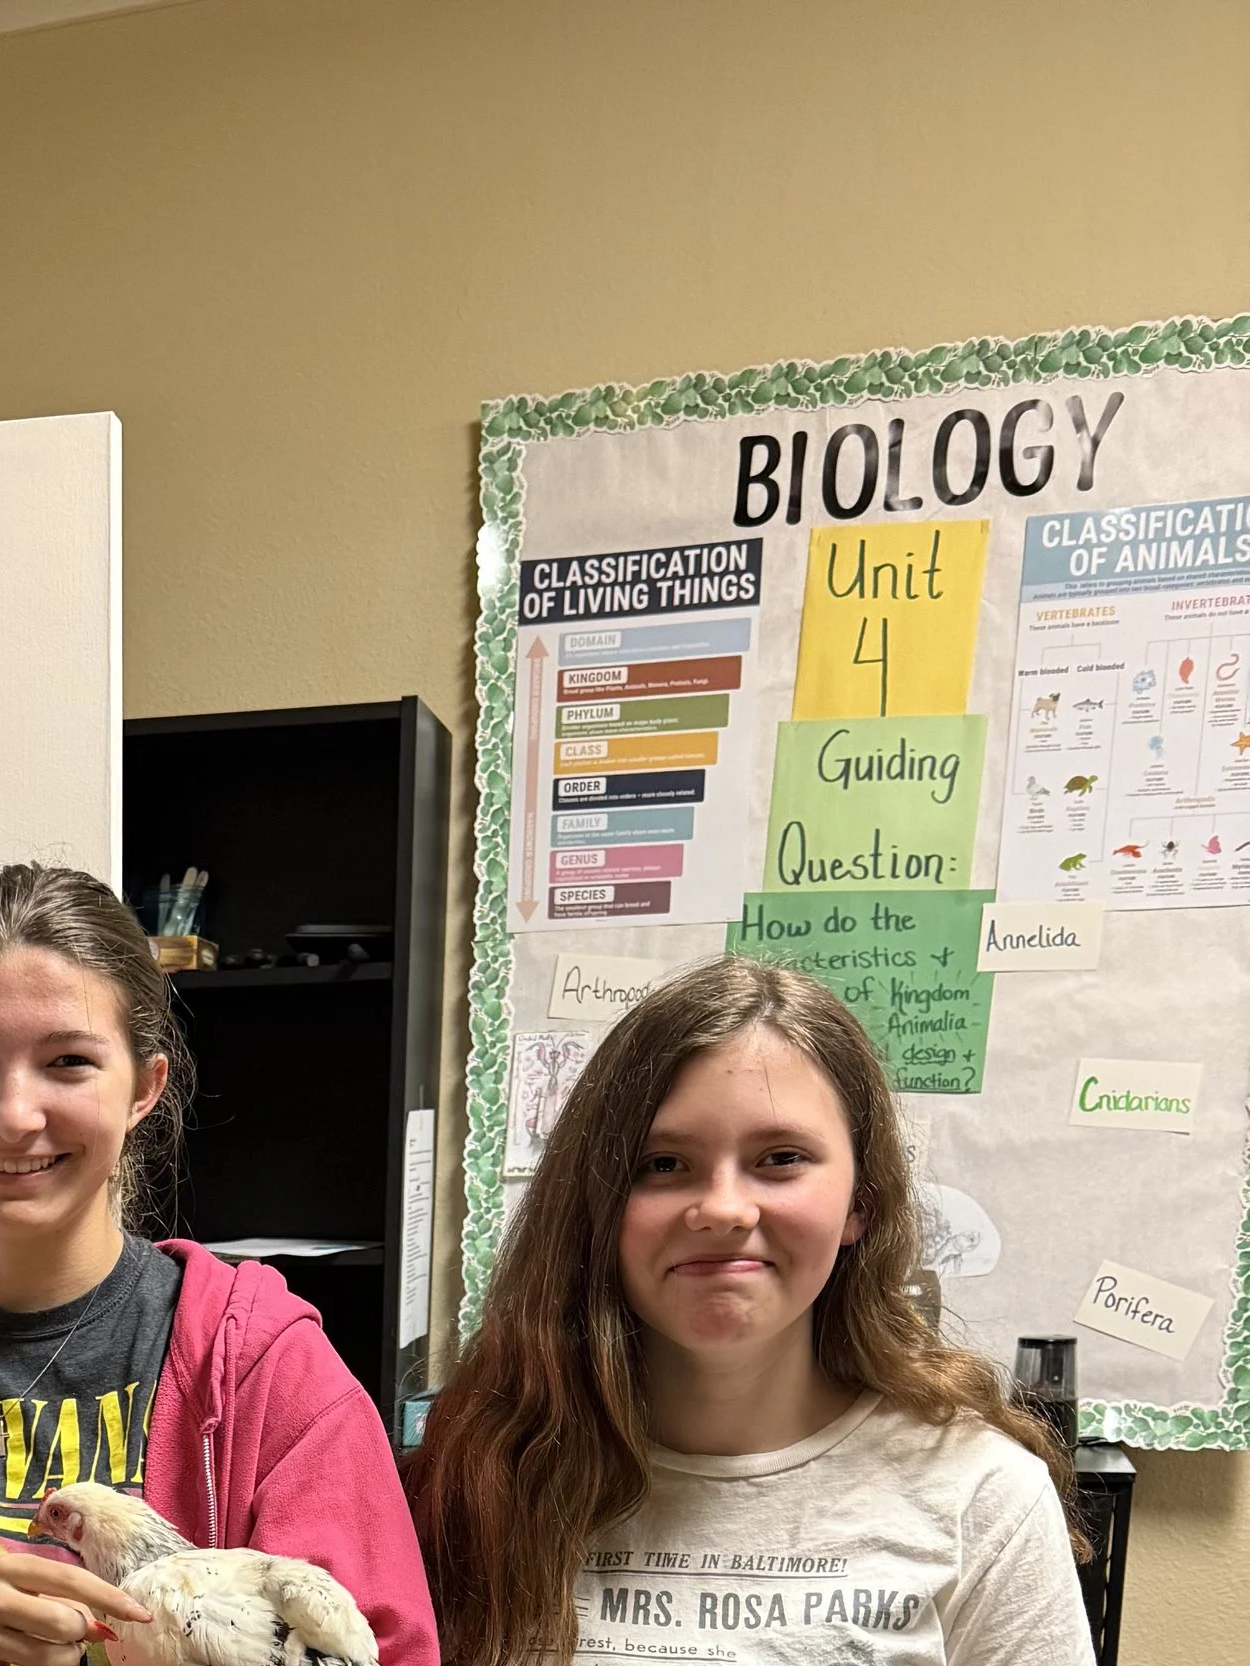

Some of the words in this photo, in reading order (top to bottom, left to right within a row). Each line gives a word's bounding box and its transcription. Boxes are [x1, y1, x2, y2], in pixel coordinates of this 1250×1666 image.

[733, 391, 1125, 528] BIOLOGY
[1041, 503, 1250, 548] CLASSIFICATI
[533, 543, 749, 590] CLASSIFICATION
[826, 529, 945, 601] Unit
[1069, 547, 1107, 577] OF
[1113, 534, 1250, 573] ANIMALS
[522, 591, 556, 619] OF
[563, 583, 649, 616] LIVING
[656, 573, 756, 607] THINGS
[1035, 605, 1117, 622] VERTEBRATES
[569, 634, 617, 649] DOMAIN
[567, 670, 622, 685] KINGDOM
[852, 617, 888, 717] 4
[1039, 665, 1069, 676] blooded
[1077, 663, 1094, 674] Cold
[1095, 661, 1125, 673] blooded
[566, 706, 614, 721] PHYLUM
[565, 744, 602, 757] CLASS
[817, 729, 960, 804] Guiding
[563, 780, 601, 793] ORDER
[561, 816, 602, 830] FAMILY
[560, 853, 598, 867] GENUS
[777, 820, 958, 886] Question:
[559, 888, 607, 902] SPECIES
[741, 904, 812, 942] How
[823, 906, 857, 934] do
[870, 902, 916, 932] the
[986, 919, 1081, 953] Annelida
[798, 946, 917, 973] cteristics
[844, 976, 875, 1003] of
[890, 977, 970, 1016] Kingdom
[887, 1010, 968, 1037] Animalia
[902, 1043, 957, 1067] design
[1078, 1076, 1192, 1115] Cnidarians
[1092, 1275, 1175, 1334] Porifera
[586, 1551, 634, 1567] FIRST
[644, 1553, 691, 1569] TIME
[700, 1554, 720, 1569] IN
[731, 1555, 849, 1573] BALTIMORE!
[600, 1587, 683, 1627] MRS.
[699, 1592, 788, 1631] ROSA
[803, 1589, 920, 1630] PARKS
[578, 1636, 616, 1652] rest,
[625, 1637, 698, 1657] because
[707, 1644, 737, 1659] she
